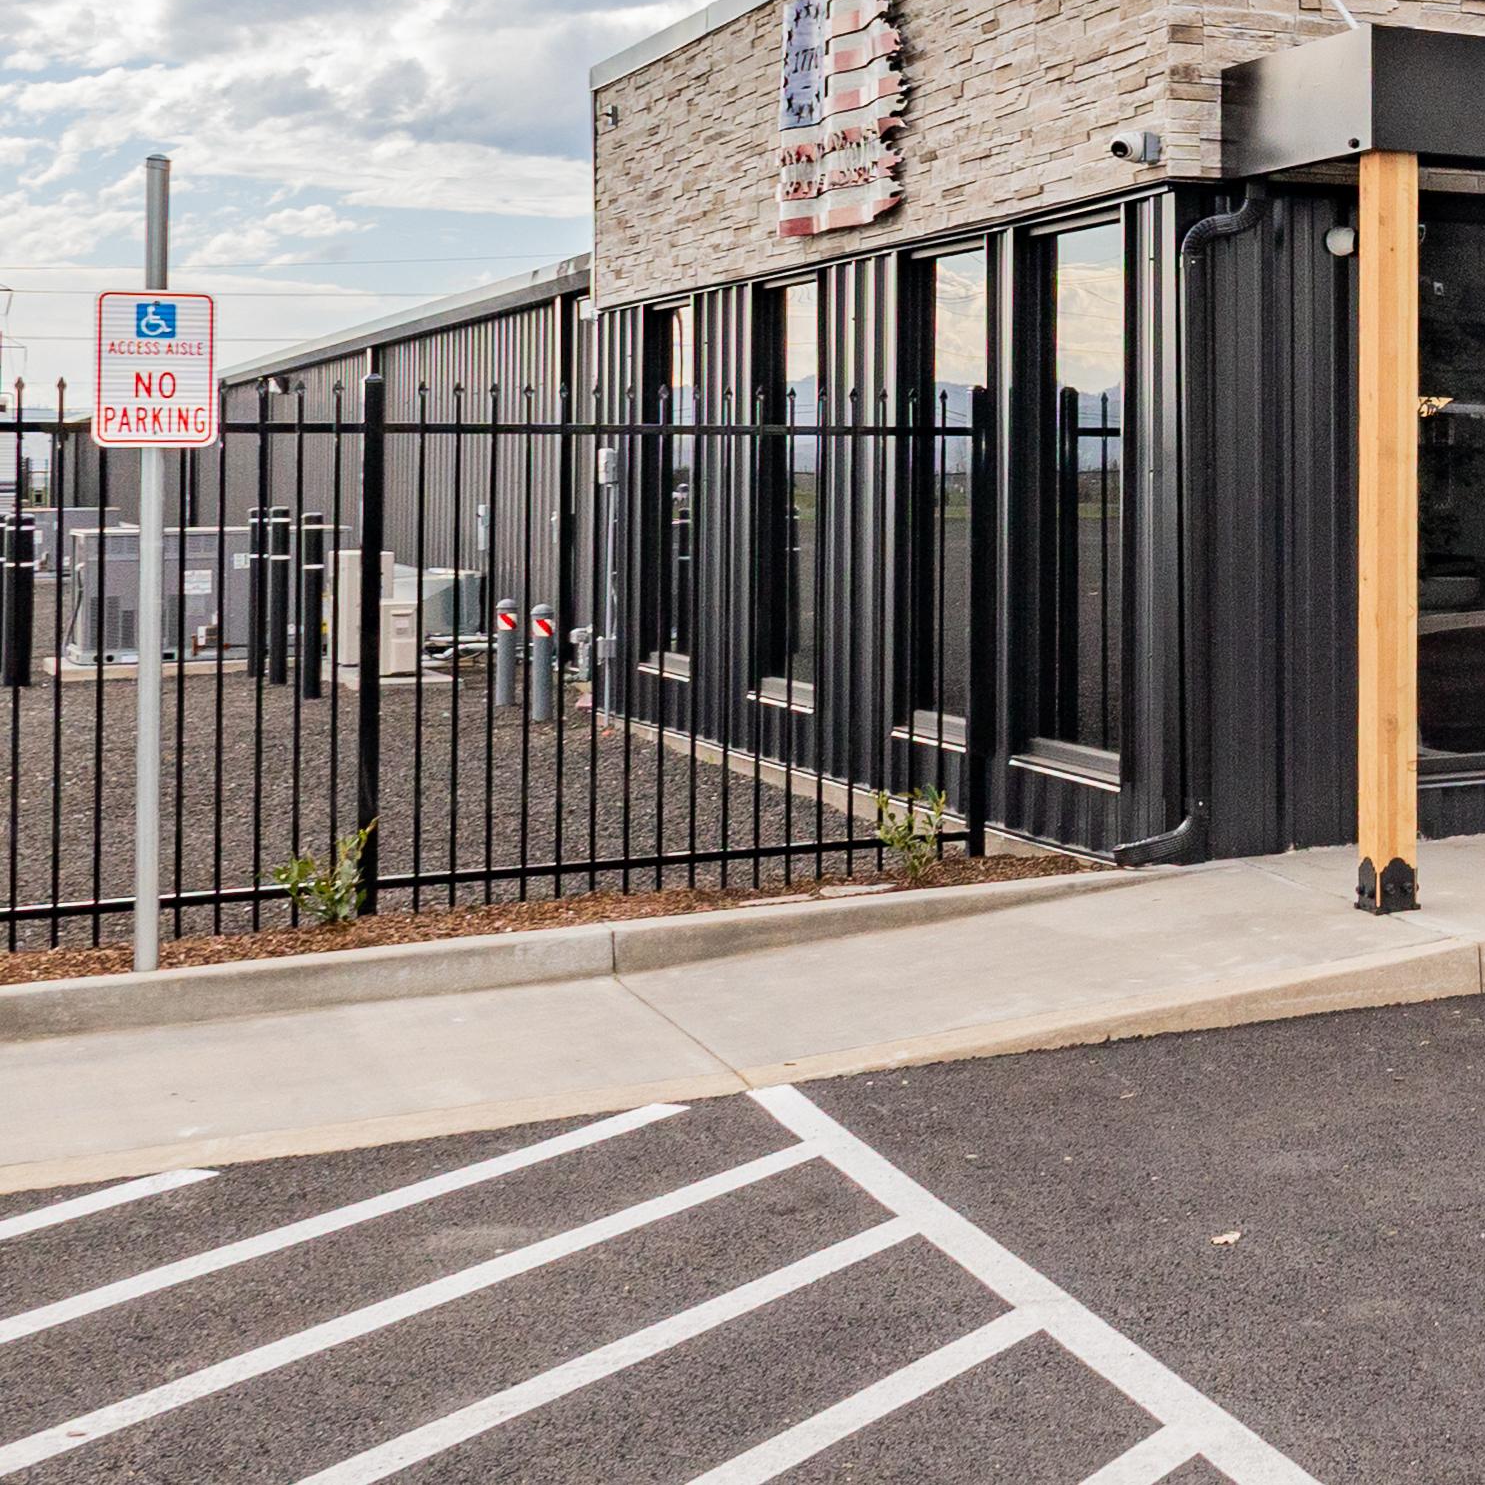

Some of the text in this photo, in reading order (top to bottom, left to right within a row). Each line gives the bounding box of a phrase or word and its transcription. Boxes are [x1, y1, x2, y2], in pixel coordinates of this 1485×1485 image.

[108, 341, 205, 356] ACCESS AISLE
[134, 372, 176, 399] NO
[104, 407, 206, 434] PARKING
